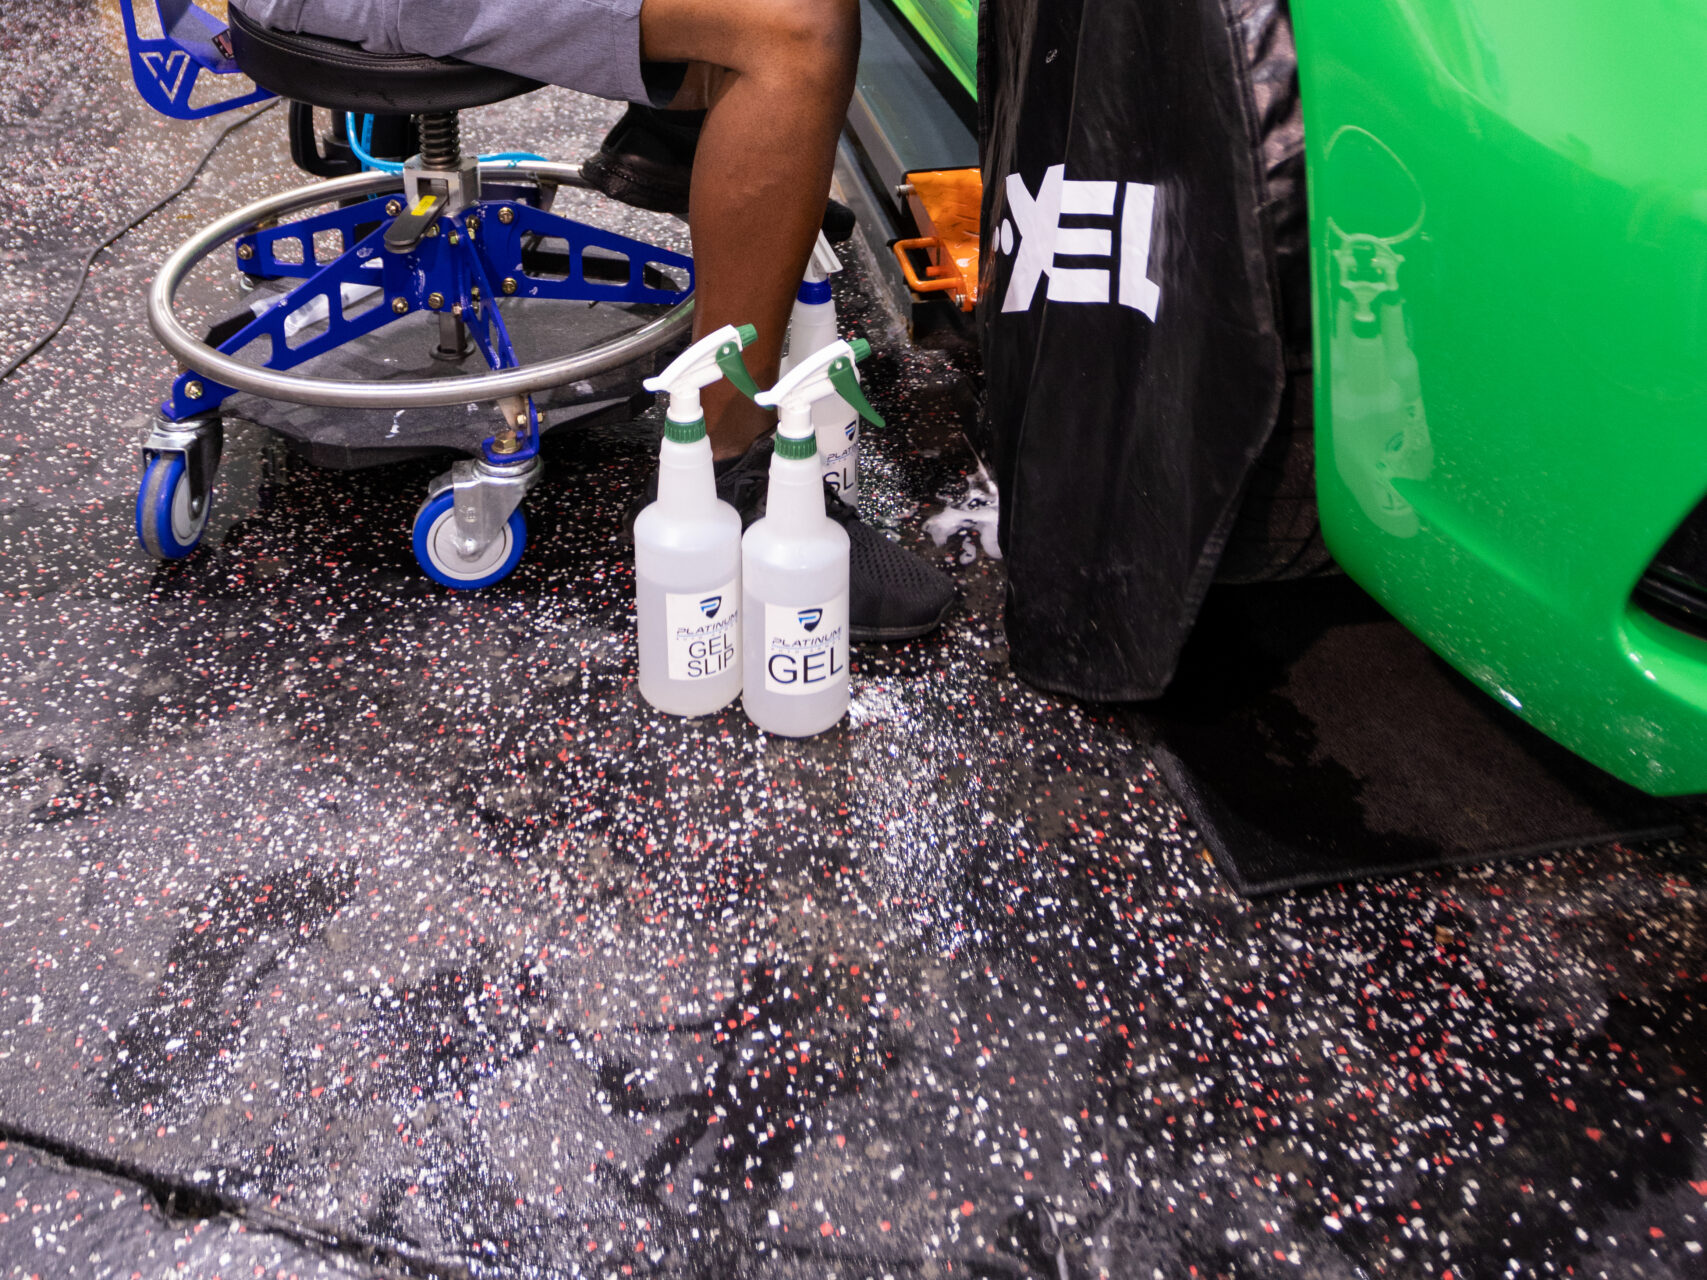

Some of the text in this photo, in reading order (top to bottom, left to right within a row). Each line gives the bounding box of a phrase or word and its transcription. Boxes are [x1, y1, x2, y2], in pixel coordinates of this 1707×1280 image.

[676, 609, 738, 636] PLATINUM
[688, 632, 733, 660] GEL
[771, 626, 842, 648] PLATINUM
[687, 647, 735, 678] SLIP
[767, 646, 844, 685] GEL
